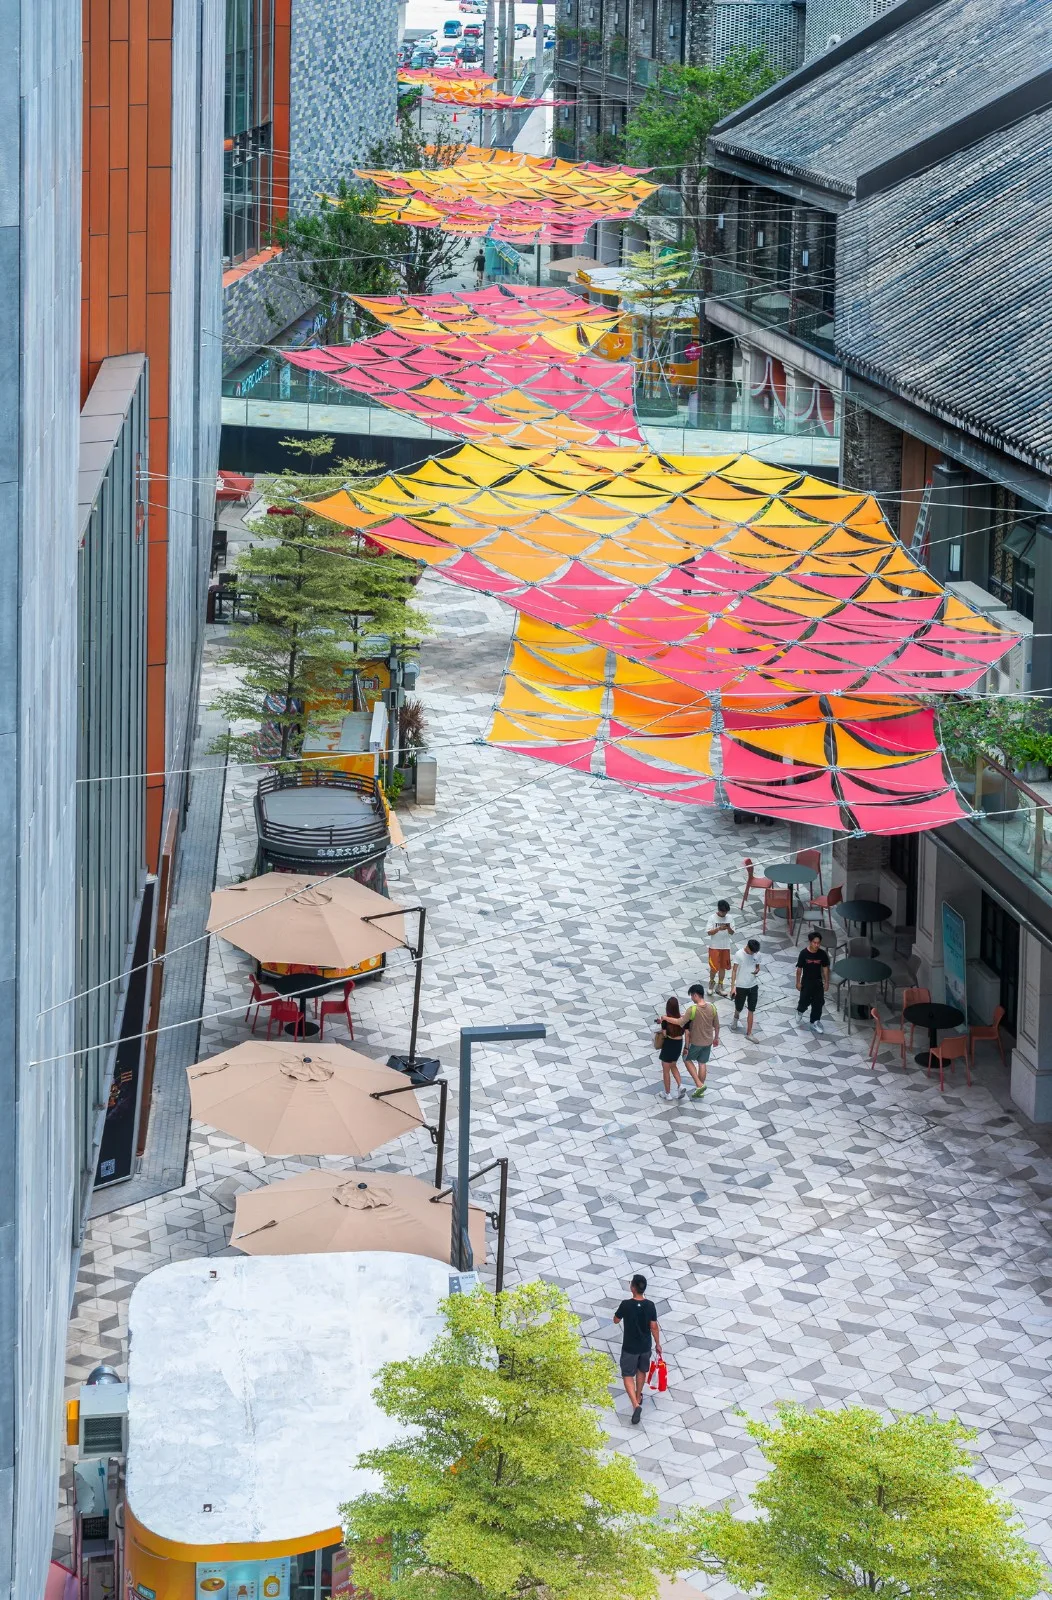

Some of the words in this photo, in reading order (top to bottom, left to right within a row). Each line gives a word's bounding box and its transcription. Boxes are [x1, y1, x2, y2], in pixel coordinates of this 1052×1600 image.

[317, 843, 375, 857] 非物质文化遗产
